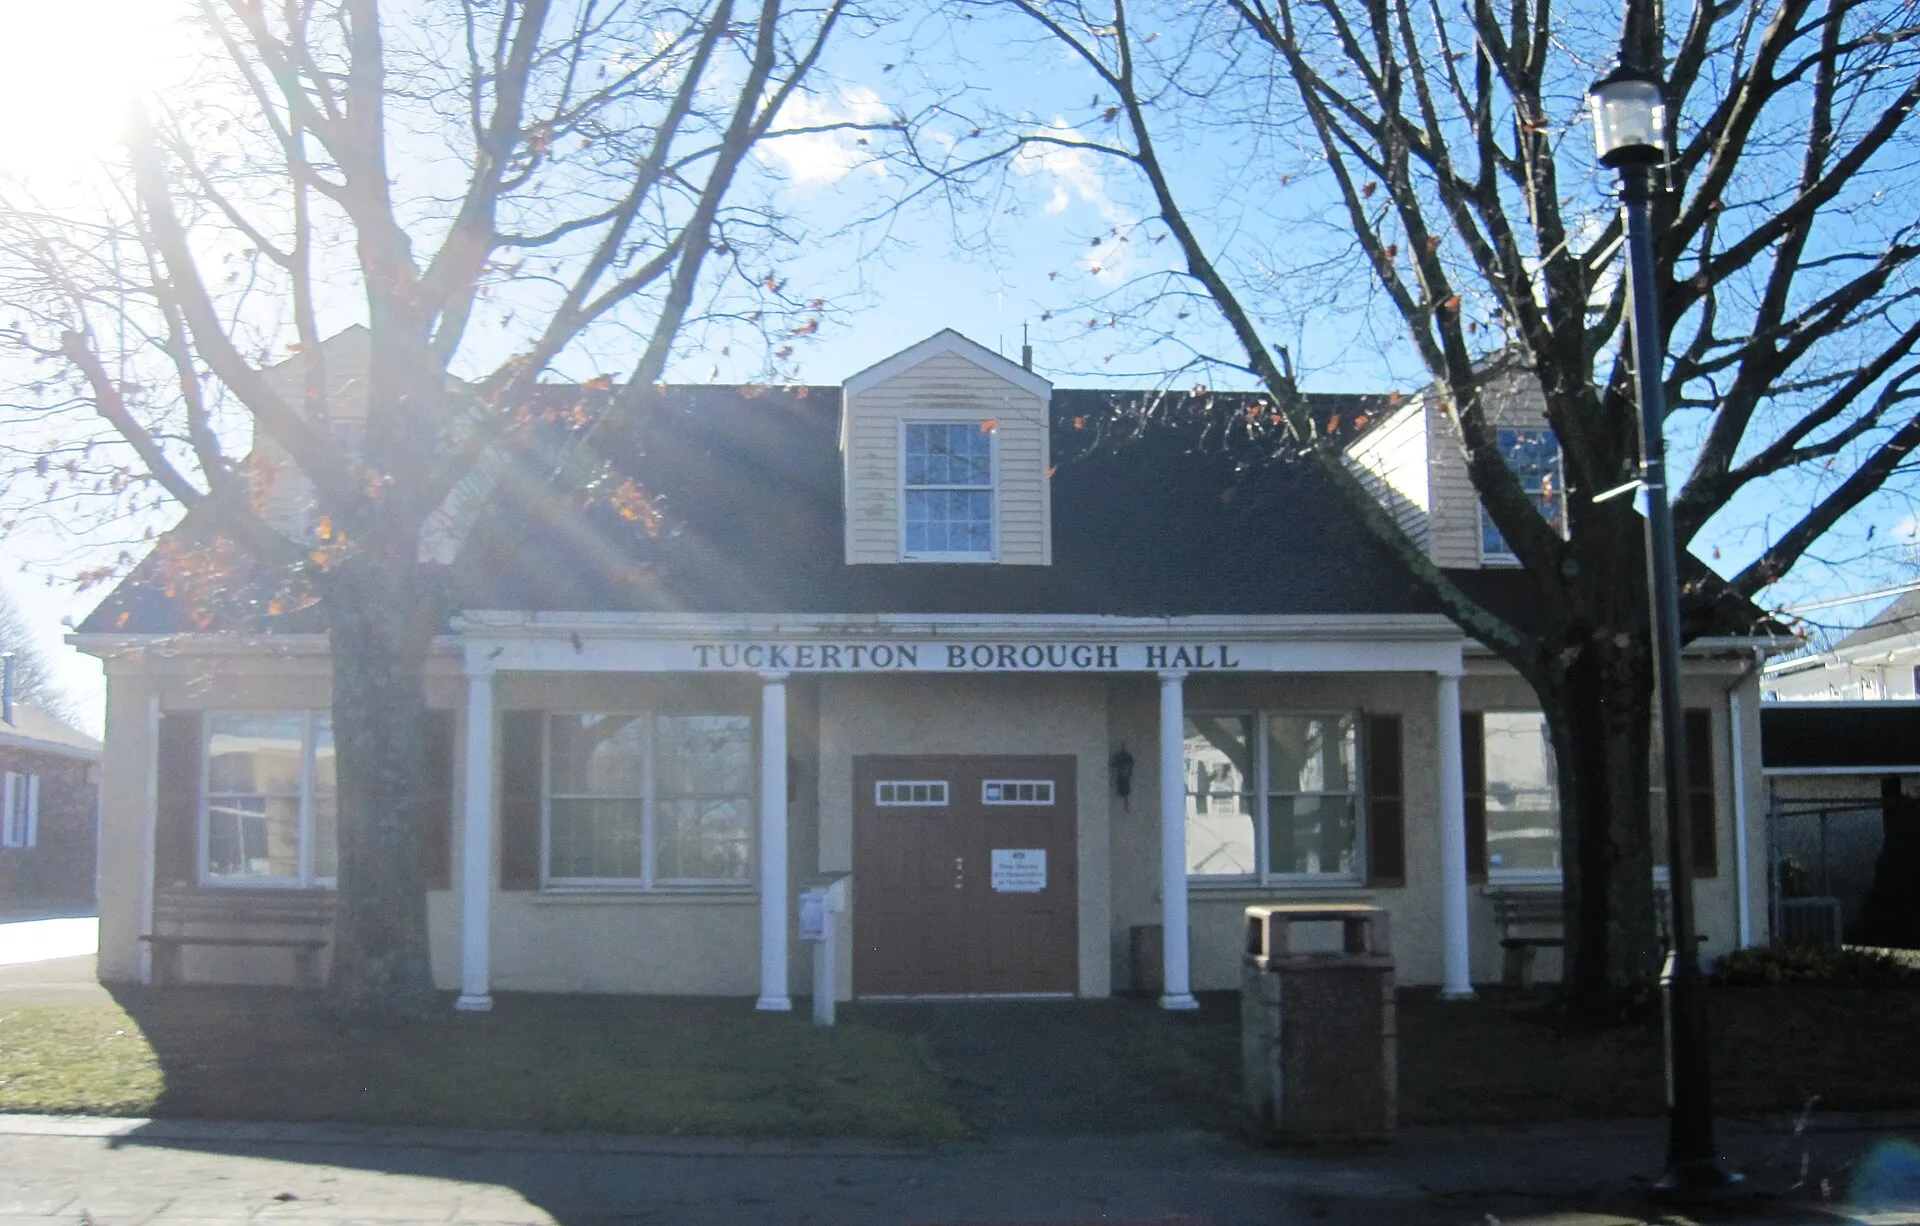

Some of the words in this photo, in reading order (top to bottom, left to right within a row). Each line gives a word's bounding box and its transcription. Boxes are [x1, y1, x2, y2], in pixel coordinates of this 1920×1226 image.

[693, 644, 918, 668] TUCKERTON
[947, 644, 1118, 668] BOROUGH
[1146, 644, 1239, 668] HALL
